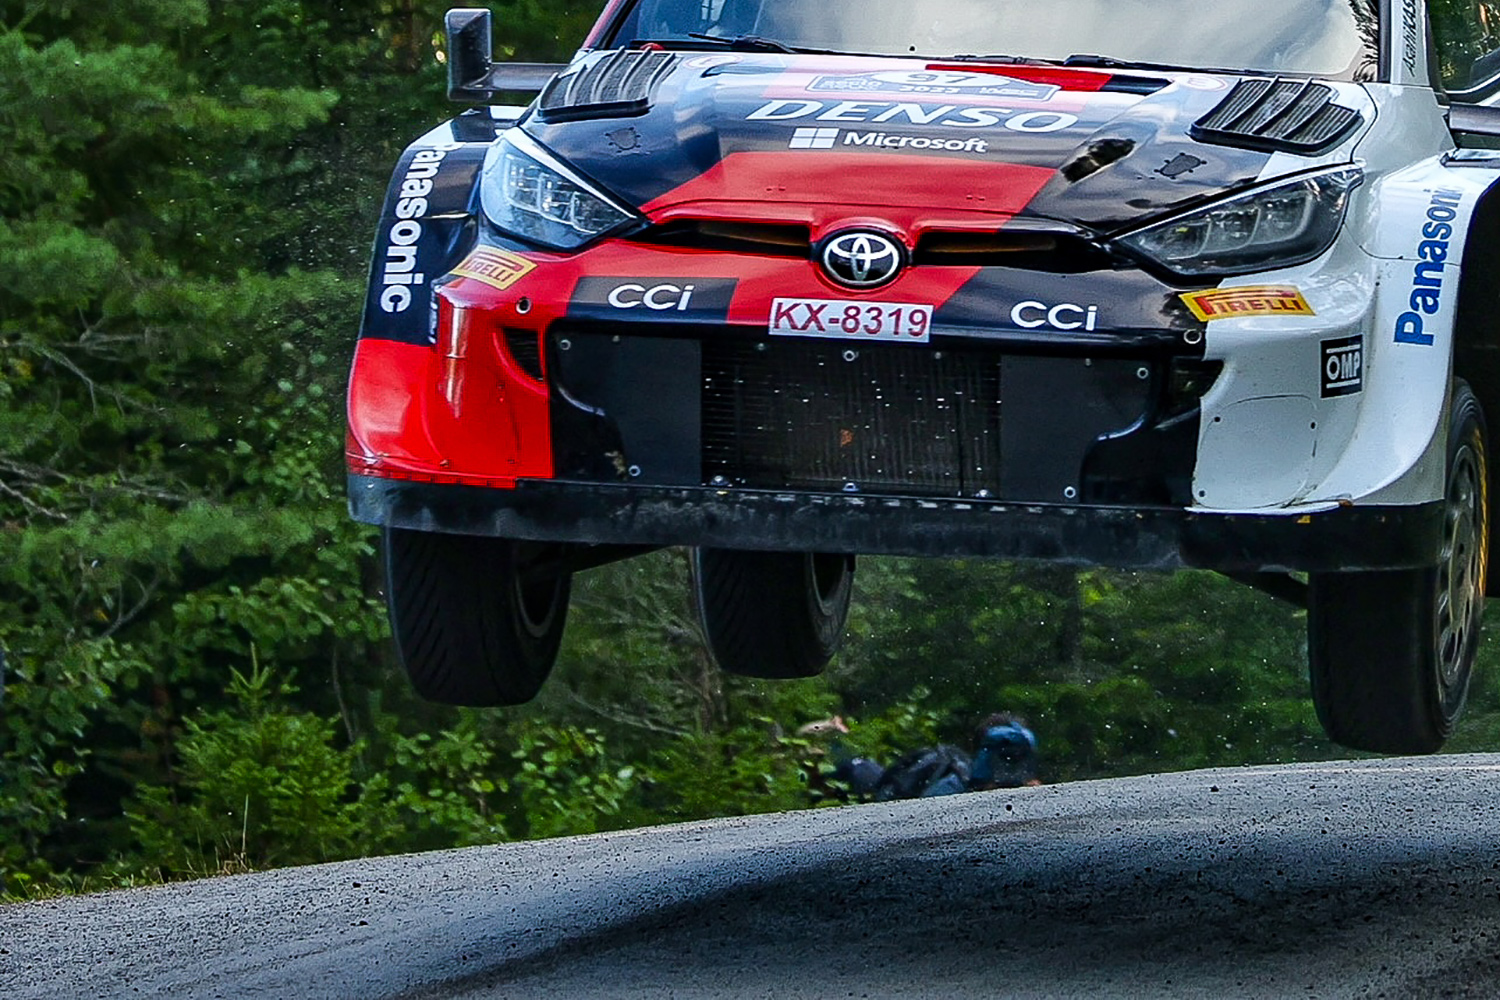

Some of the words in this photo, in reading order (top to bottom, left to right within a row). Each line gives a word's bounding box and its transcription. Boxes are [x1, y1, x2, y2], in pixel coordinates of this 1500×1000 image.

[744, 99, 1080, 133] DENSO
[843, 131, 989, 154] Microsoft
[380, 141, 468, 313] Panasonic
[458, 251, 524, 283] PIRELLI
[1194, 287, 1305, 317] PIRELLI
[773, 301, 930, 338] KX-8319
[1326, 350, 1361, 381] OMP
